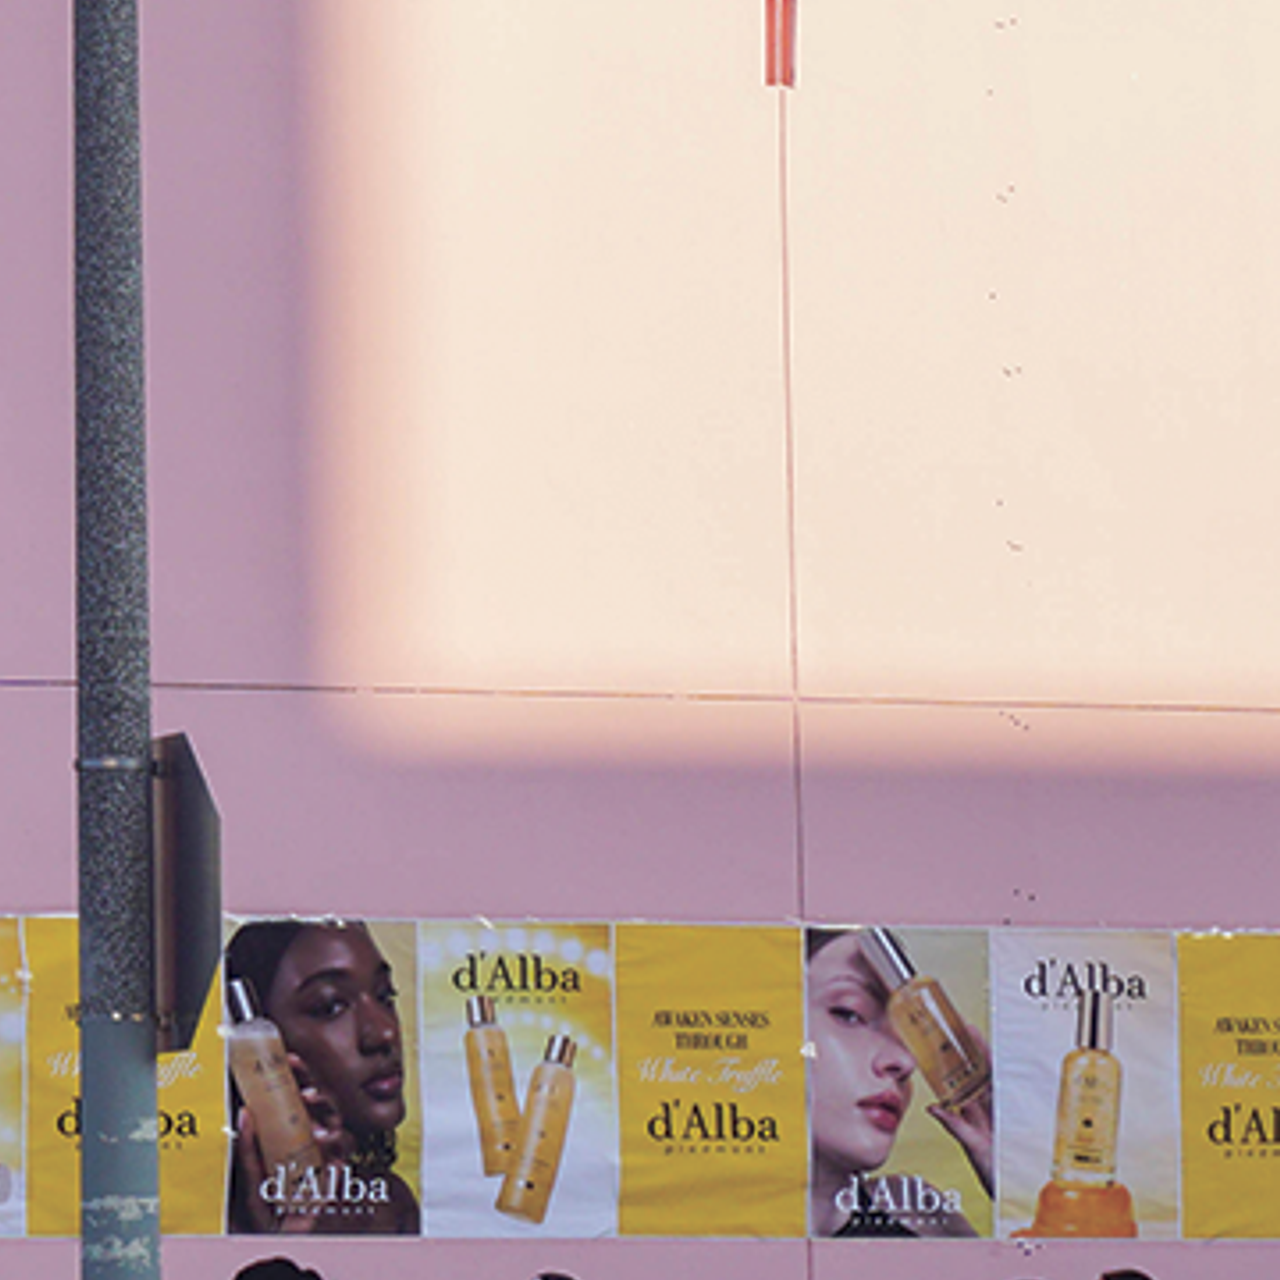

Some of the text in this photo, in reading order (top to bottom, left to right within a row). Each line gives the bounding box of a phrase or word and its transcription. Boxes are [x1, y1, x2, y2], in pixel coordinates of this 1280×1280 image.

[452, 950, 582, 993] d'Alba
[1023, 957, 1147, 1000] d'Alba
[646, 1098, 781, 1142] d'Alba
[259, 1161, 390, 1204] d'Alba
[835, 1170, 964, 1214] d'Alba
